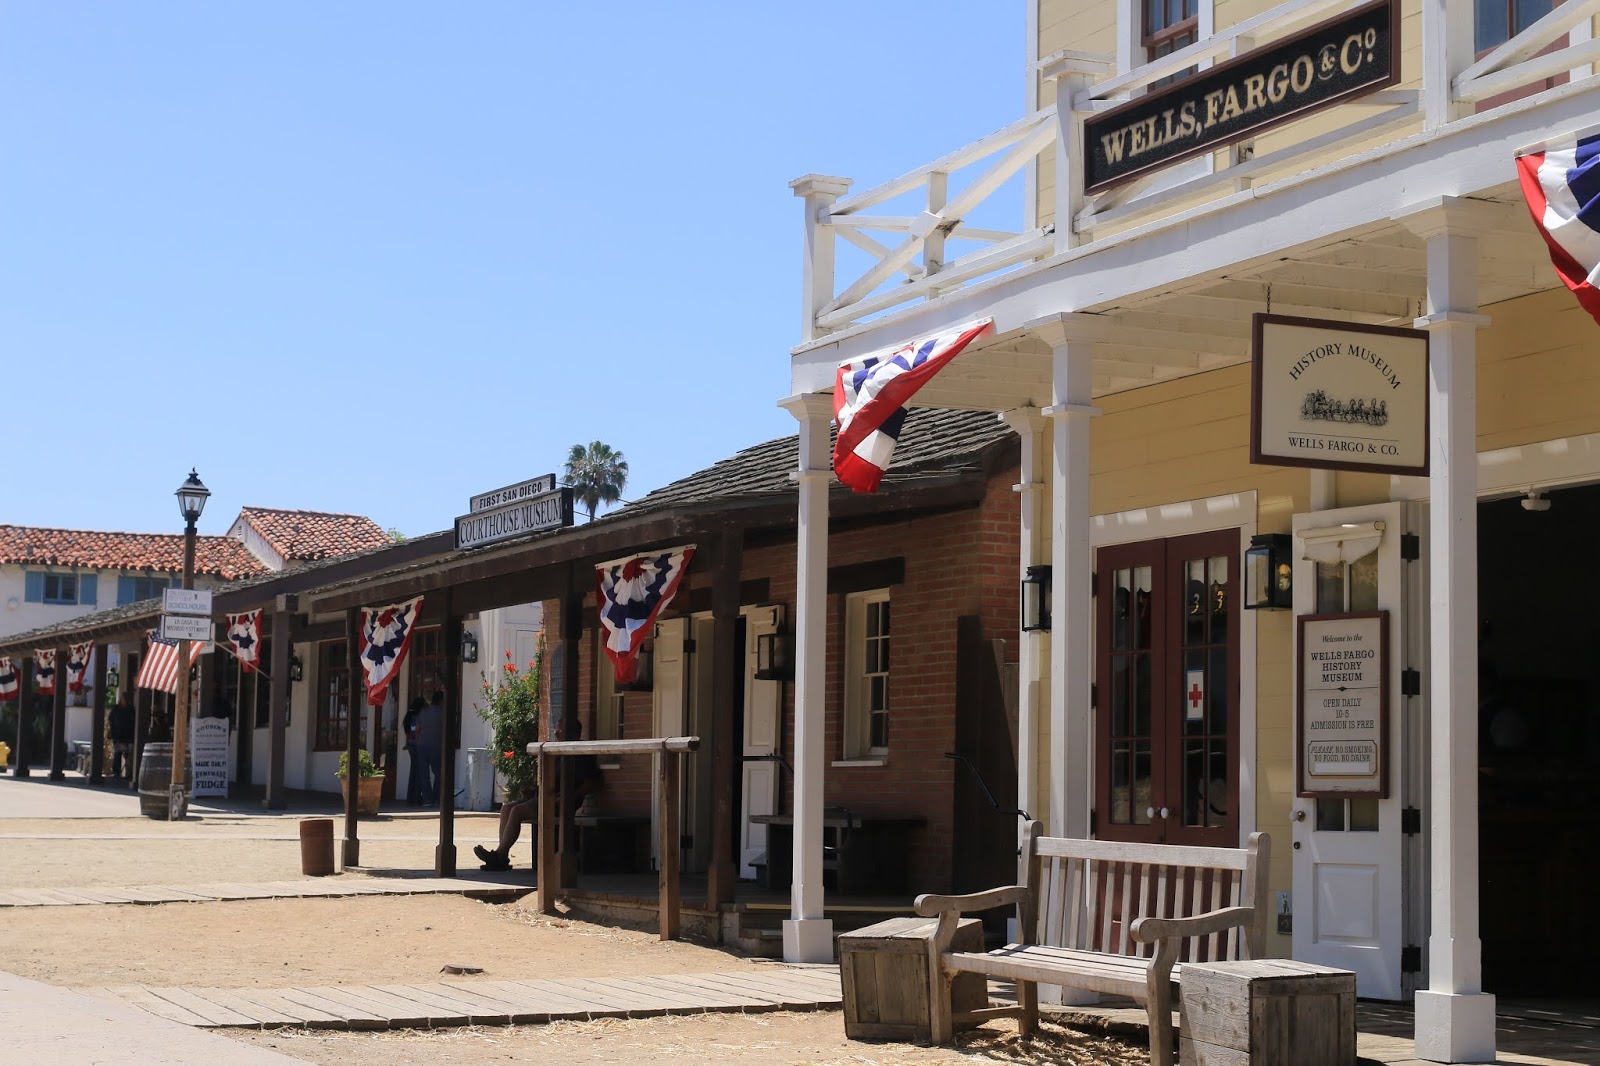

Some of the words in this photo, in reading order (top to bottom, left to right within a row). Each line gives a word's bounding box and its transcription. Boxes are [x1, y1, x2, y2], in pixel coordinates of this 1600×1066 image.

[1100, 101, 1203, 166] WELLS,
[1203, 54, 1315, 128] FARGO
[1317, 43, 1338, 81] &
[1288, 343, 1343, 381] HISTORY
[1347, 344, 1402, 390] MUSEUM
[1288, 437, 1324, 450] WELLS
[1328, 440, 1364, 453] FARGO
[1367, 443, 1378, 454] &
[1381, 444, 1400, 456] CO.
[479, 494, 501, 509] FIRST
[502, 489, 517, 502] SAN
[519, 482, 542, 497] DIEGO
[460, 508, 520, 544] COURTHOUSE
[521, 496, 562, 529] MUSEUM
[1322, 634, 1345, 643] Welcome
[1353, 633, 1363, 641] the
[1311, 651, 1341, 661] WELLS
[1344, 649, 1375, 660] FARGO
[1322, 661, 1362, 672] HISTORY
[1322, 672, 1362, 683] MUSEUM
[1323, 698, 1341, 708] OPEN
[1342, 697, 1362, 707] DAILY
[1335, 709, 1349, 719] 10-5
[1310, 720, 1347, 730] ADMISSION
[1349, 720, 1355, 729] IS
[1356, 720, 1374, 729] FREE
[1335, 745, 1343, 754] NO
[1314, 754, 1322, 762] NO
[1341, 754, 1349, 762] NO
[1350, 754, 1371, 762] DRINK
